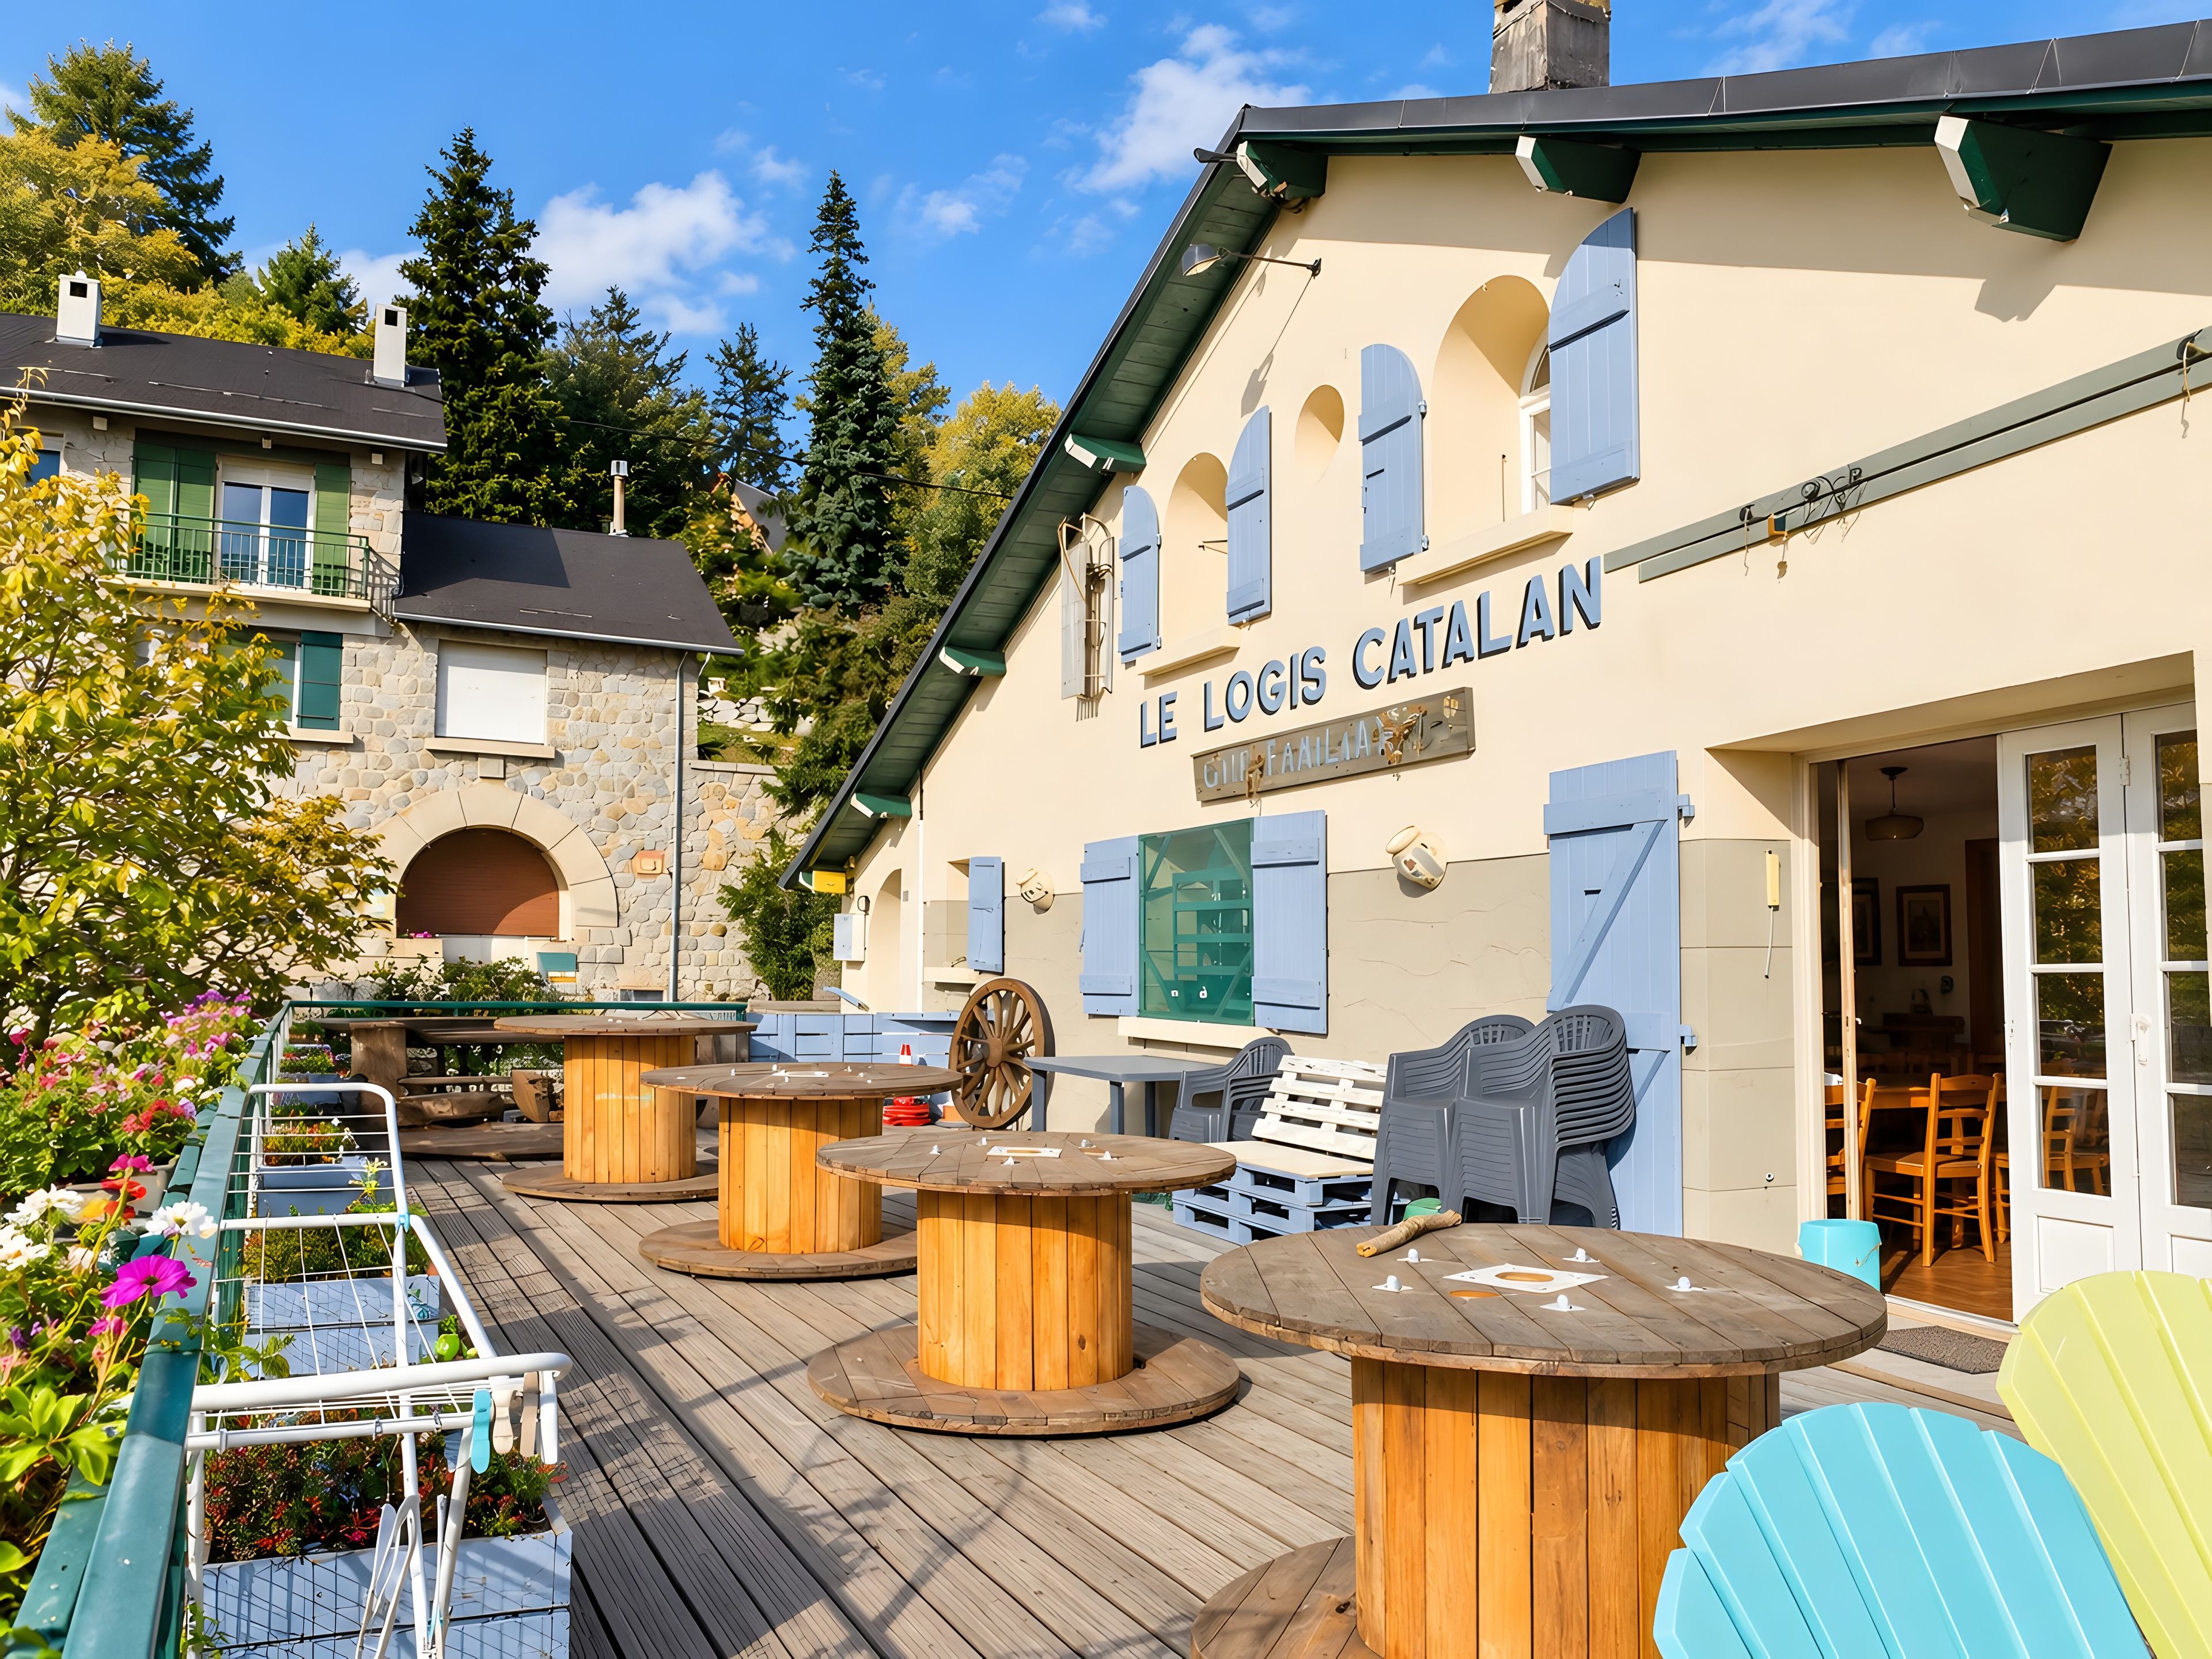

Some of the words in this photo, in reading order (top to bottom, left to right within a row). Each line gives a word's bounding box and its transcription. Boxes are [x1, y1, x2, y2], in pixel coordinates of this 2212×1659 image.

[1140, 691, 1178, 749] LE
[1203, 646, 1327, 733] LOGIS
[1353, 555, 1601, 690] CATALAN
